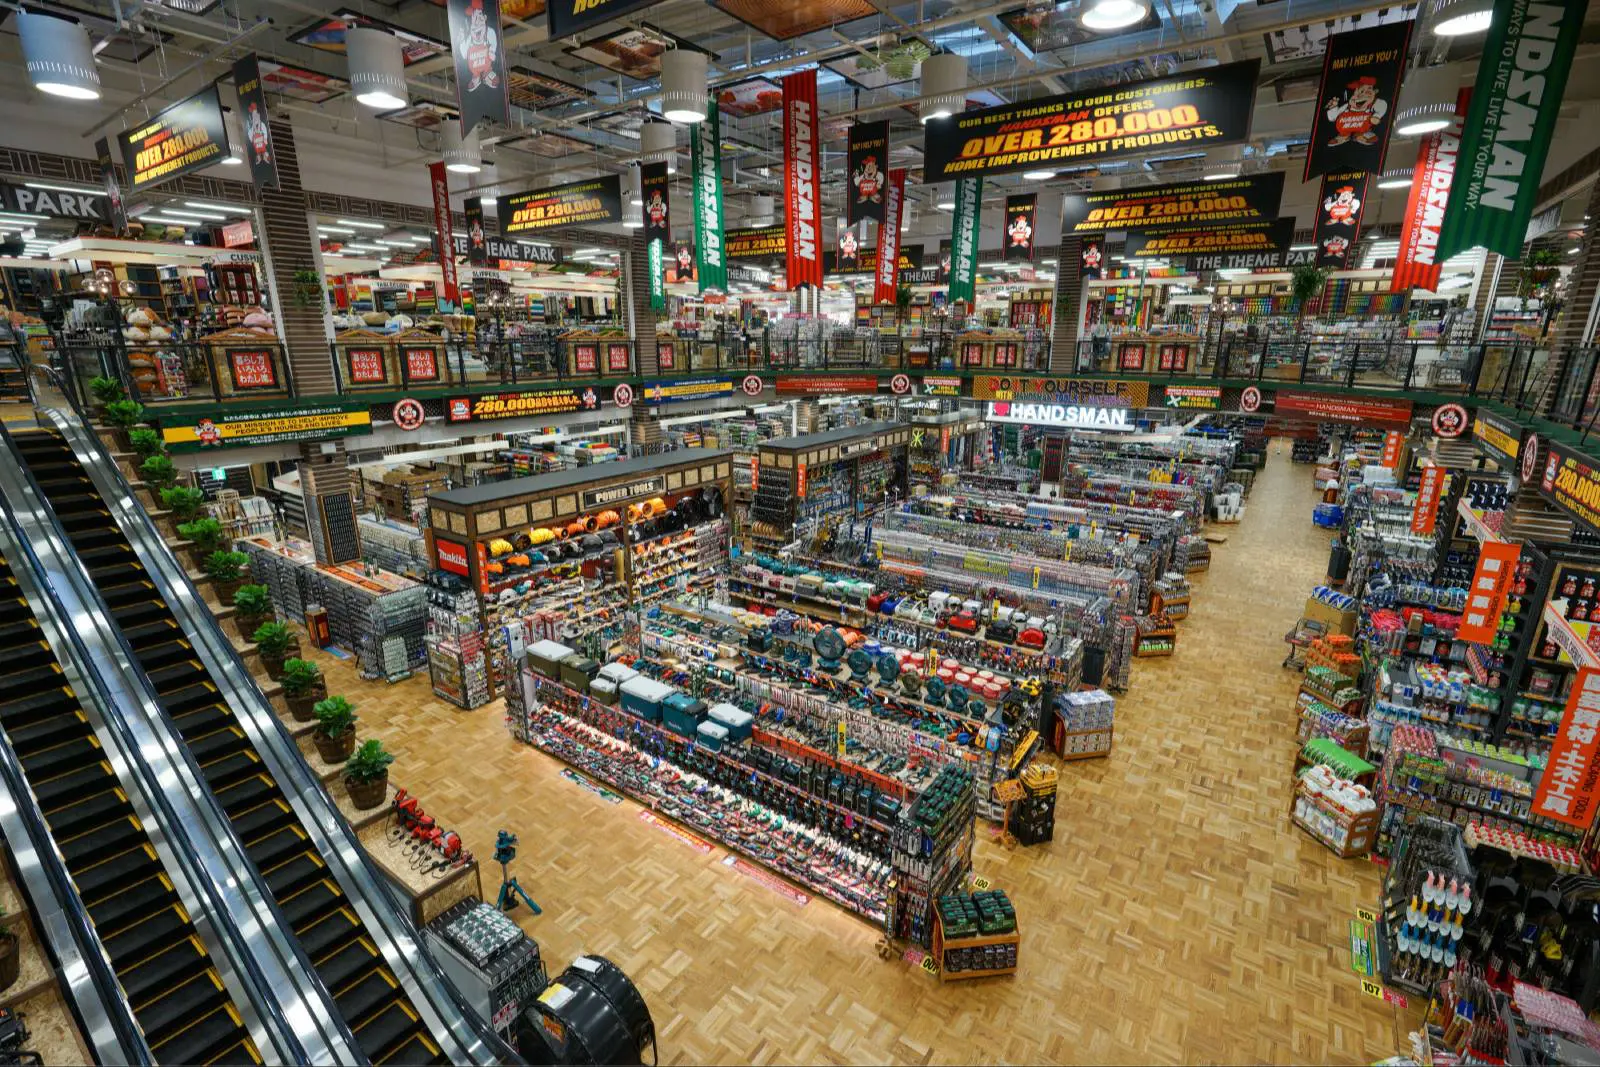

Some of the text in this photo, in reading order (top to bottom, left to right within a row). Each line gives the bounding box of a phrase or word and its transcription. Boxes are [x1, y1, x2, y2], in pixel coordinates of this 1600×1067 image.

[1503, 40, 1517, 58] TO
[1333, 56, 1349, 70] MAY
[1354, 52, 1375, 66] HELP
[1376, 49, 1392, 63] YOU
[959, 119, 982, 129] OUR
[984, 112, 1013, 125] BEST
[1016, 103, 1063, 119] THANKS
[1067, 100, 1083, 110] TO
[1085, 95, 1112, 106] OUR
[1094, 100, 1154, 117] OFFERS
[1480, 3, 1566, 211] NDSMAN
[1485, 98, 1502, 126] LIVE
[1482, 127, 1493, 140] IT
[943, 125, 1223, 173] HOME IMPROVEMENT PRODUCTS.
[960, 129, 1043, 158] OVER
[136, 145, 163, 170] OVER
[1473, 144, 1490, 178] YOUR
[148, 156, 186, 181] IMPROVEMENT
[796, 99, 816, 262] HANDSMAN
[15, 188, 100, 218] PARK
[701, 121, 721, 268] HANDSMAN
[1464, 180, 1482, 211] WAY.
[513, 206, 545, 222] OVER
[1074, 222, 1105, 231] HOME
[1105, 213, 1190, 228] IMPROVEMENT
[1087, 205, 1145, 221] OVER
[525, 216, 571, 230] IMPROVEMENT
[752, 237, 786, 249] 280,0
[883, 185, 900, 286] HANDSMAN
[1145, 237, 1190, 249] OVER
[230, 253, 259, 263] CUSHI
[523, 248, 556, 263] PARK
[1195, 250, 1316, 270] THE THEME PAR
[726, 267, 750, 281] THEME
[904, 271, 936, 282] THEME
[988, 377, 1128, 395] DO IT YOURSELF
[996, 391, 1012, 399] WITH
[1010, 403, 1127, 426] HANDSMAN
[1315, 403, 1358, 414] HANDSMAN
[244, 421, 276, 429] MISSION
[298, 416, 318, 425] HELP
[319, 414, 349, 423] IMPROVE
[304, 422, 320, 430] AND
[595, 482, 654, 503] POWER TOOLS
[1571, 796, 1591, 820] TOOLS
[1362, 981, 1380, 996] 107
